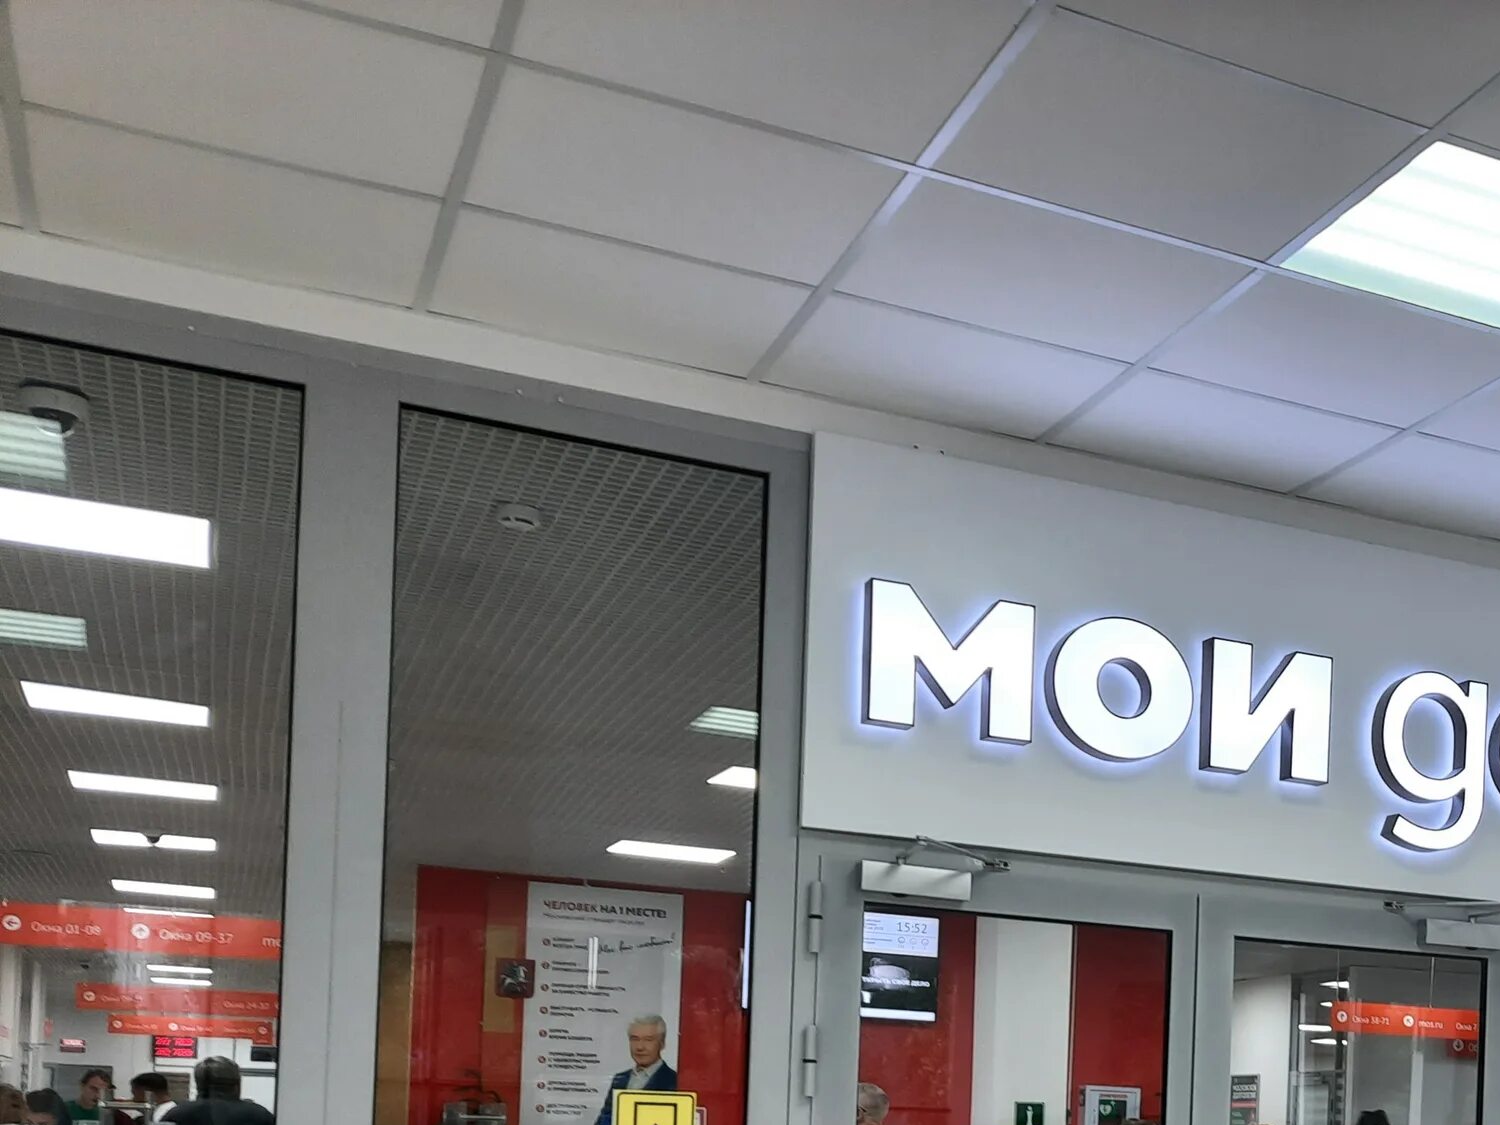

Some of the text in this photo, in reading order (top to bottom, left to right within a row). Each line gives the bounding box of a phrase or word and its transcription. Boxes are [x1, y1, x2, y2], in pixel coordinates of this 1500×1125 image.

[543, 900, 598, 913] ЧЕЛОВЕК
[599, 904, 618, 915] НА
[896, 921, 928, 934] 15:52
[159, 928, 193, 941] Окна
[1418, 1018, 1443, 1029] mos.ru
